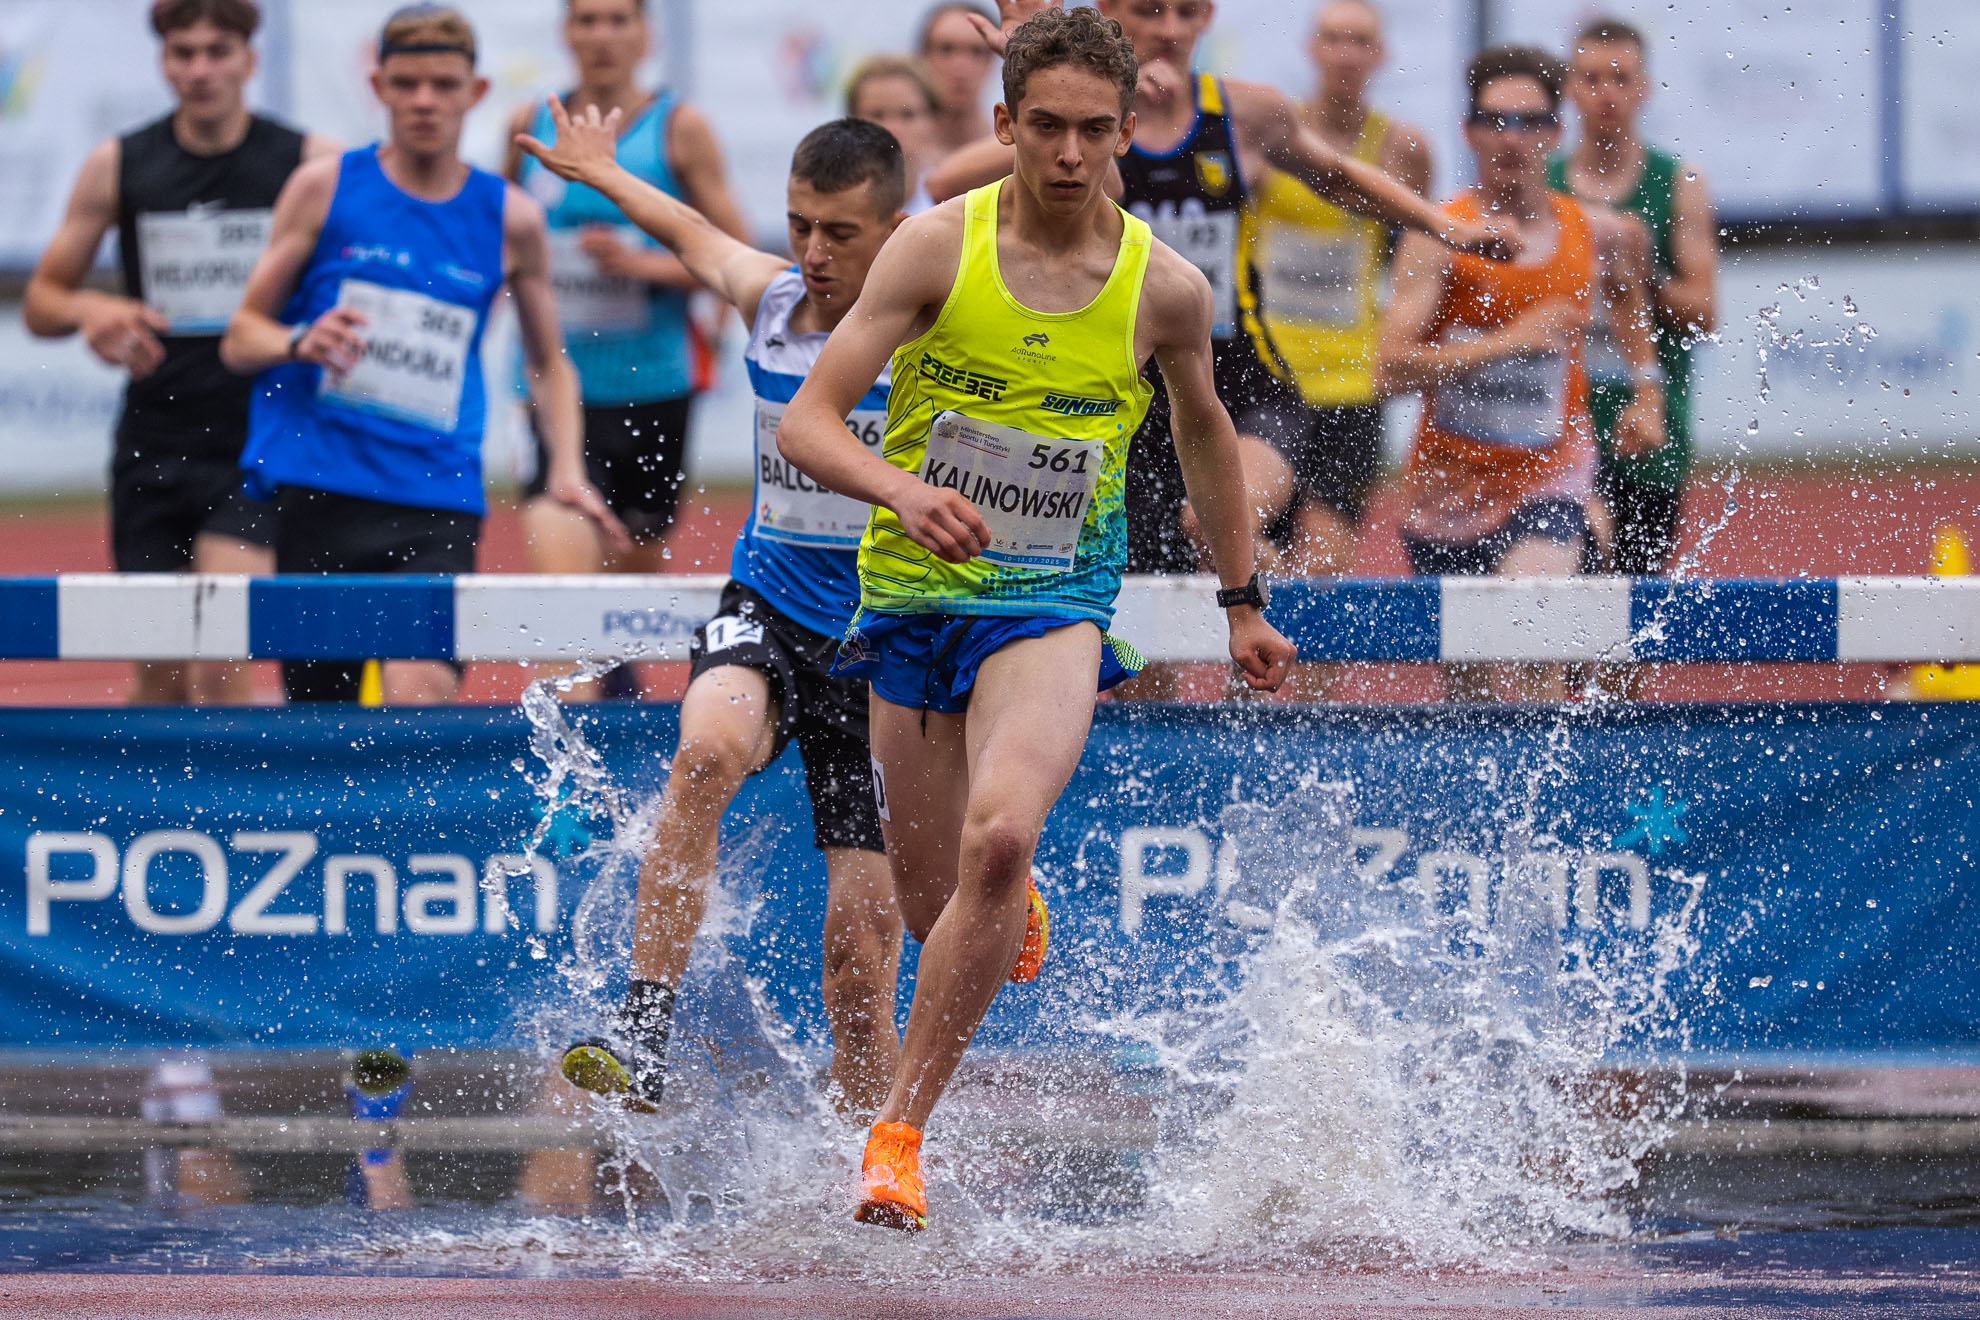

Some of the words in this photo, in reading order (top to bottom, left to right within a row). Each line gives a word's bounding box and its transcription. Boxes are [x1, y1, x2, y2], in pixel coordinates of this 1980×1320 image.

[959, 432, 979, 443] Sportu
[983, 440, 1011, 453] Turystyki
[960, 426, 1000, 443] Ministerstwo
[1028, 443, 1089, 474] 561
[924, 458, 1085, 519] KALINOWSKI
[1004, 555, 1060, 565] 10-13.07.2025
